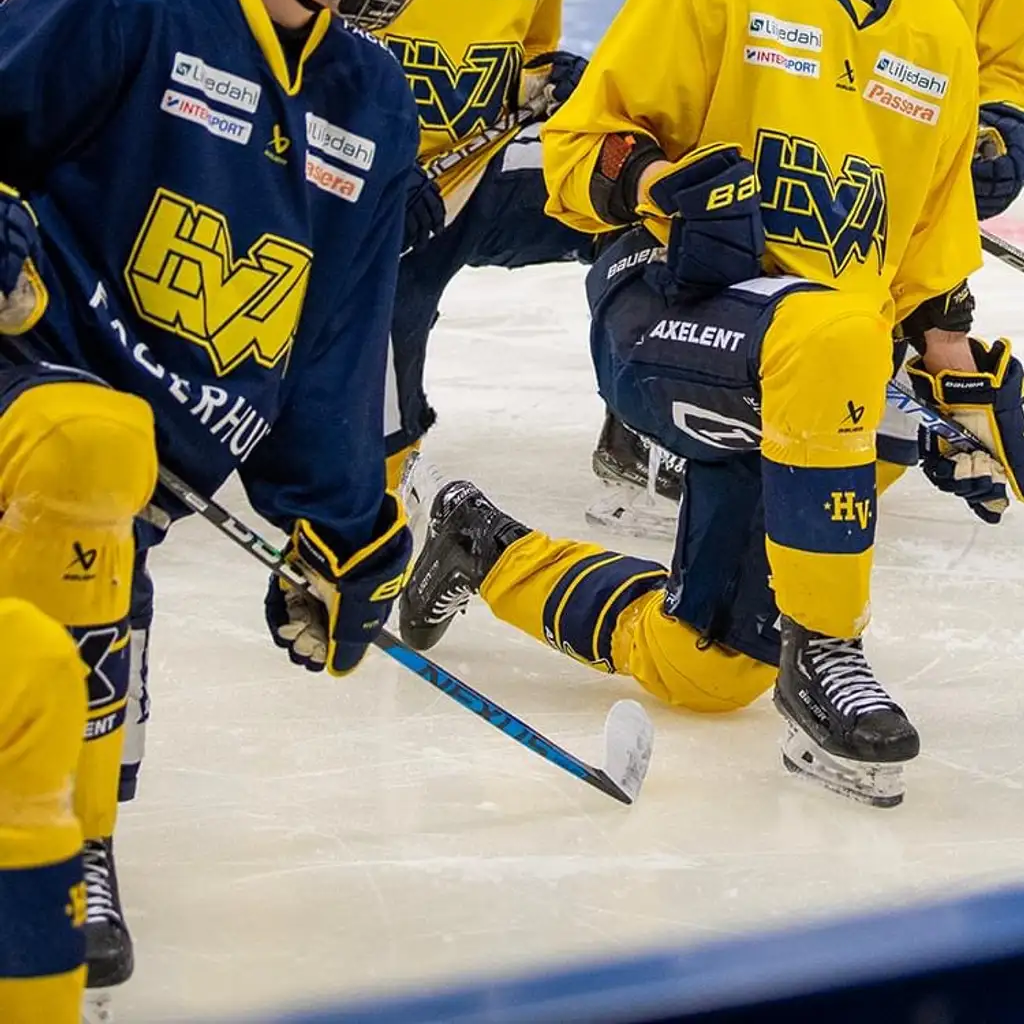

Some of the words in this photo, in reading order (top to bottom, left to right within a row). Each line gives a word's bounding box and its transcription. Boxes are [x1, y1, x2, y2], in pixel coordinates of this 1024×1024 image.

[888, 61, 946, 95] Liljedahl
[866, 82, 935, 122] Passera
[648, 319, 746, 353] AXELENT
[83, 714, 117, 739] ENT
